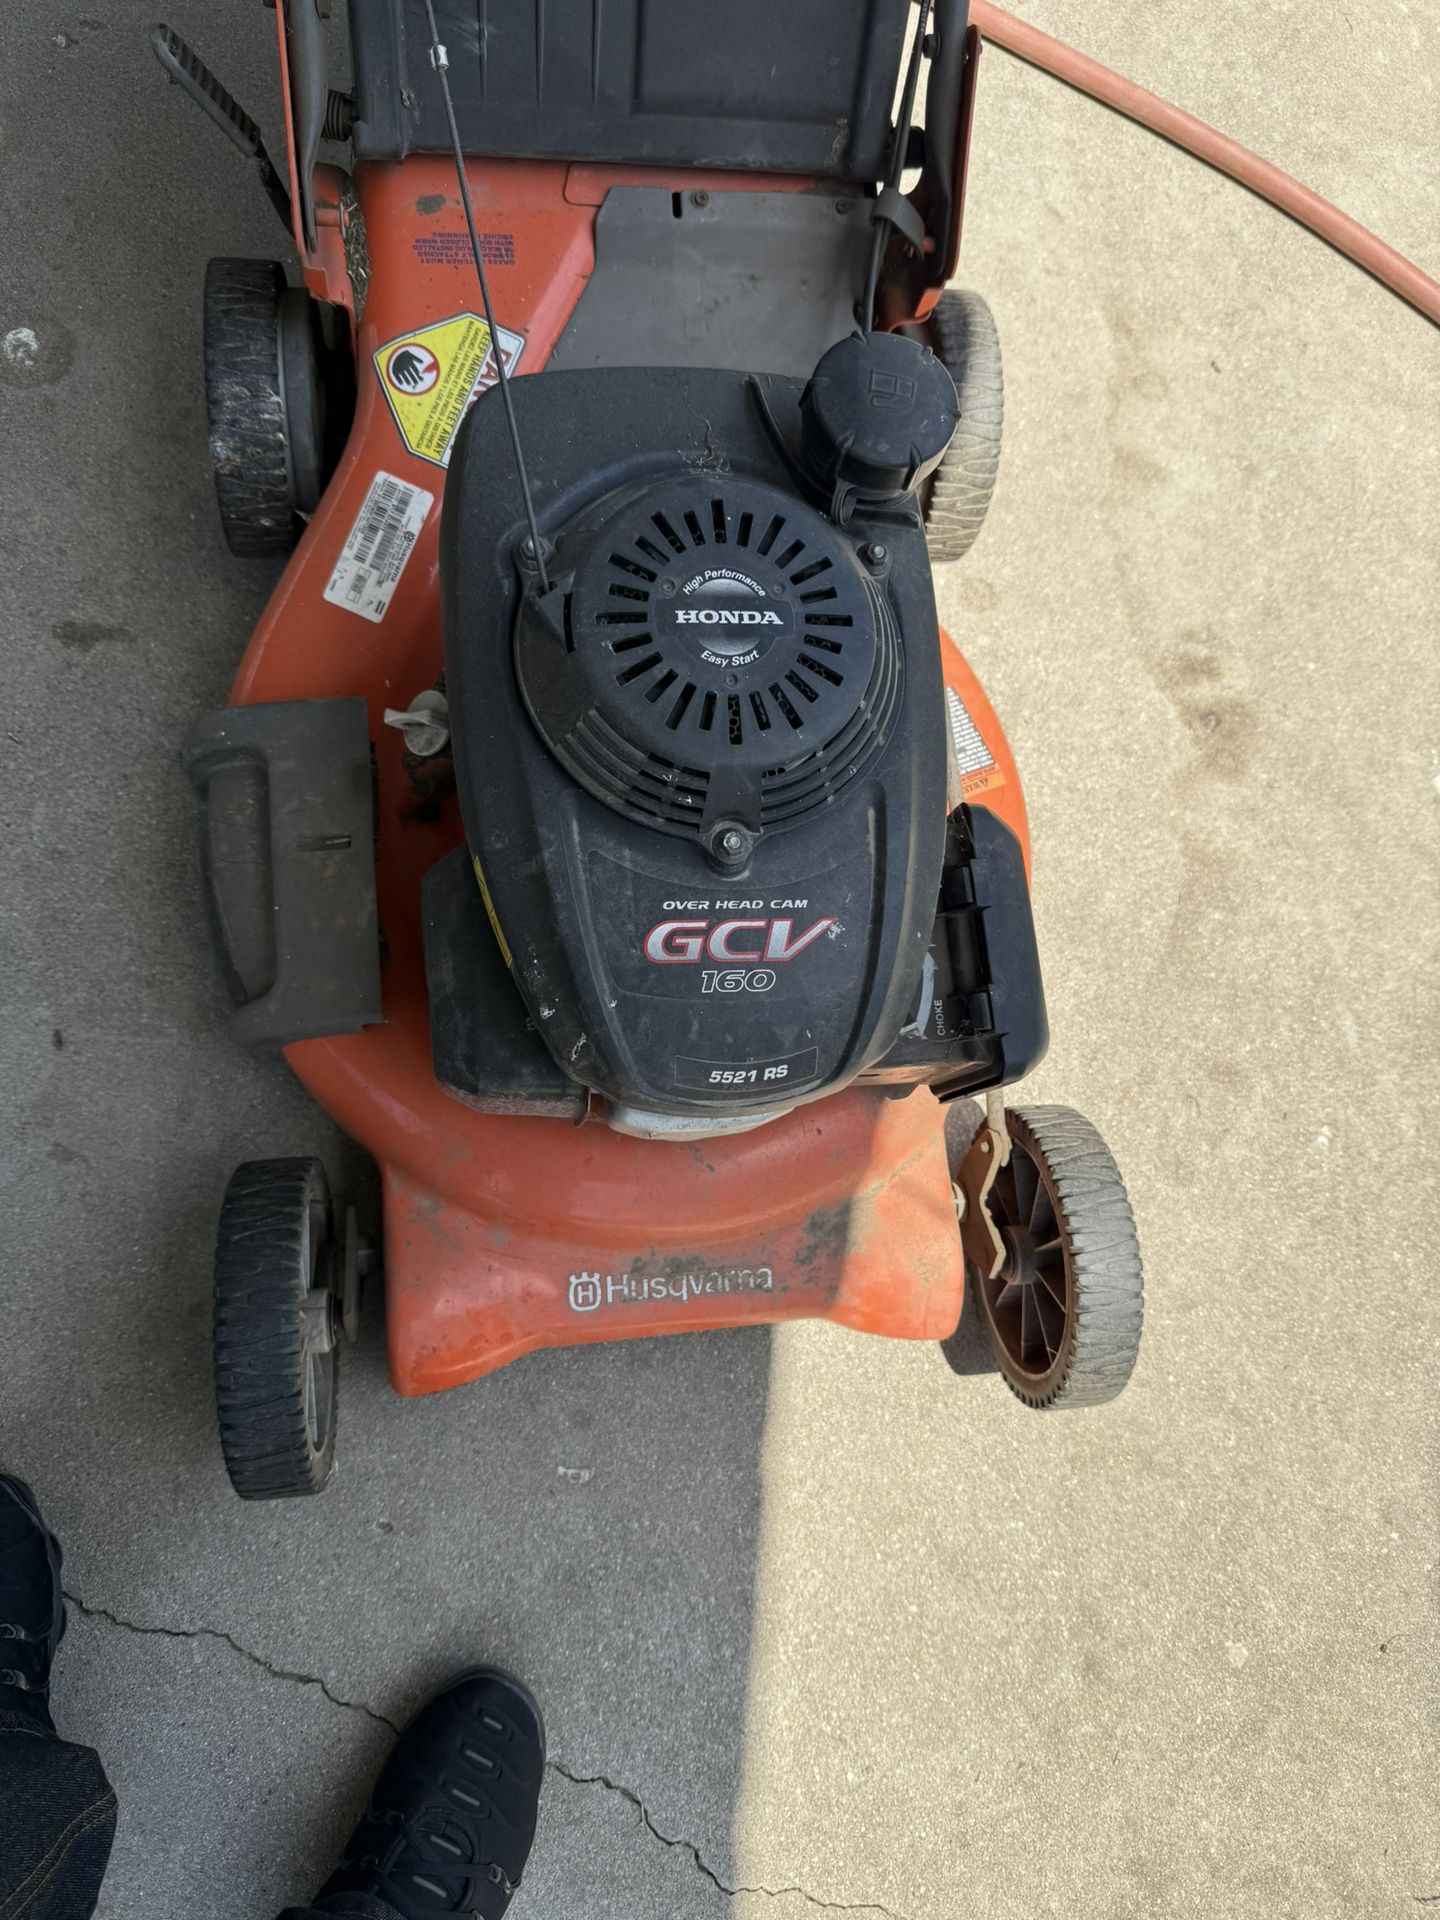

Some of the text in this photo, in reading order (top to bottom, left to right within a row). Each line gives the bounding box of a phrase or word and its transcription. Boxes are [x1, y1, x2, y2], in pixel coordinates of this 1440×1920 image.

[433, 329, 492, 456] KEEP HANDS AND FEET AWAY
[682, 568, 767, 597] High Performance
[675, 609, 784, 625] HONDA
[700, 650, 760, 668] Easy Start
[663, 899, 808, 910] OVER HEAD CAM
[644, 917, 837, 964] GCV
[701, 969, 776, 993] 160
[934, 999, 946, 1037] CHOKE
[709, 1064, 788, 1083] 5521 RS
[606, 1267, 772, 1304] Husqvarna
